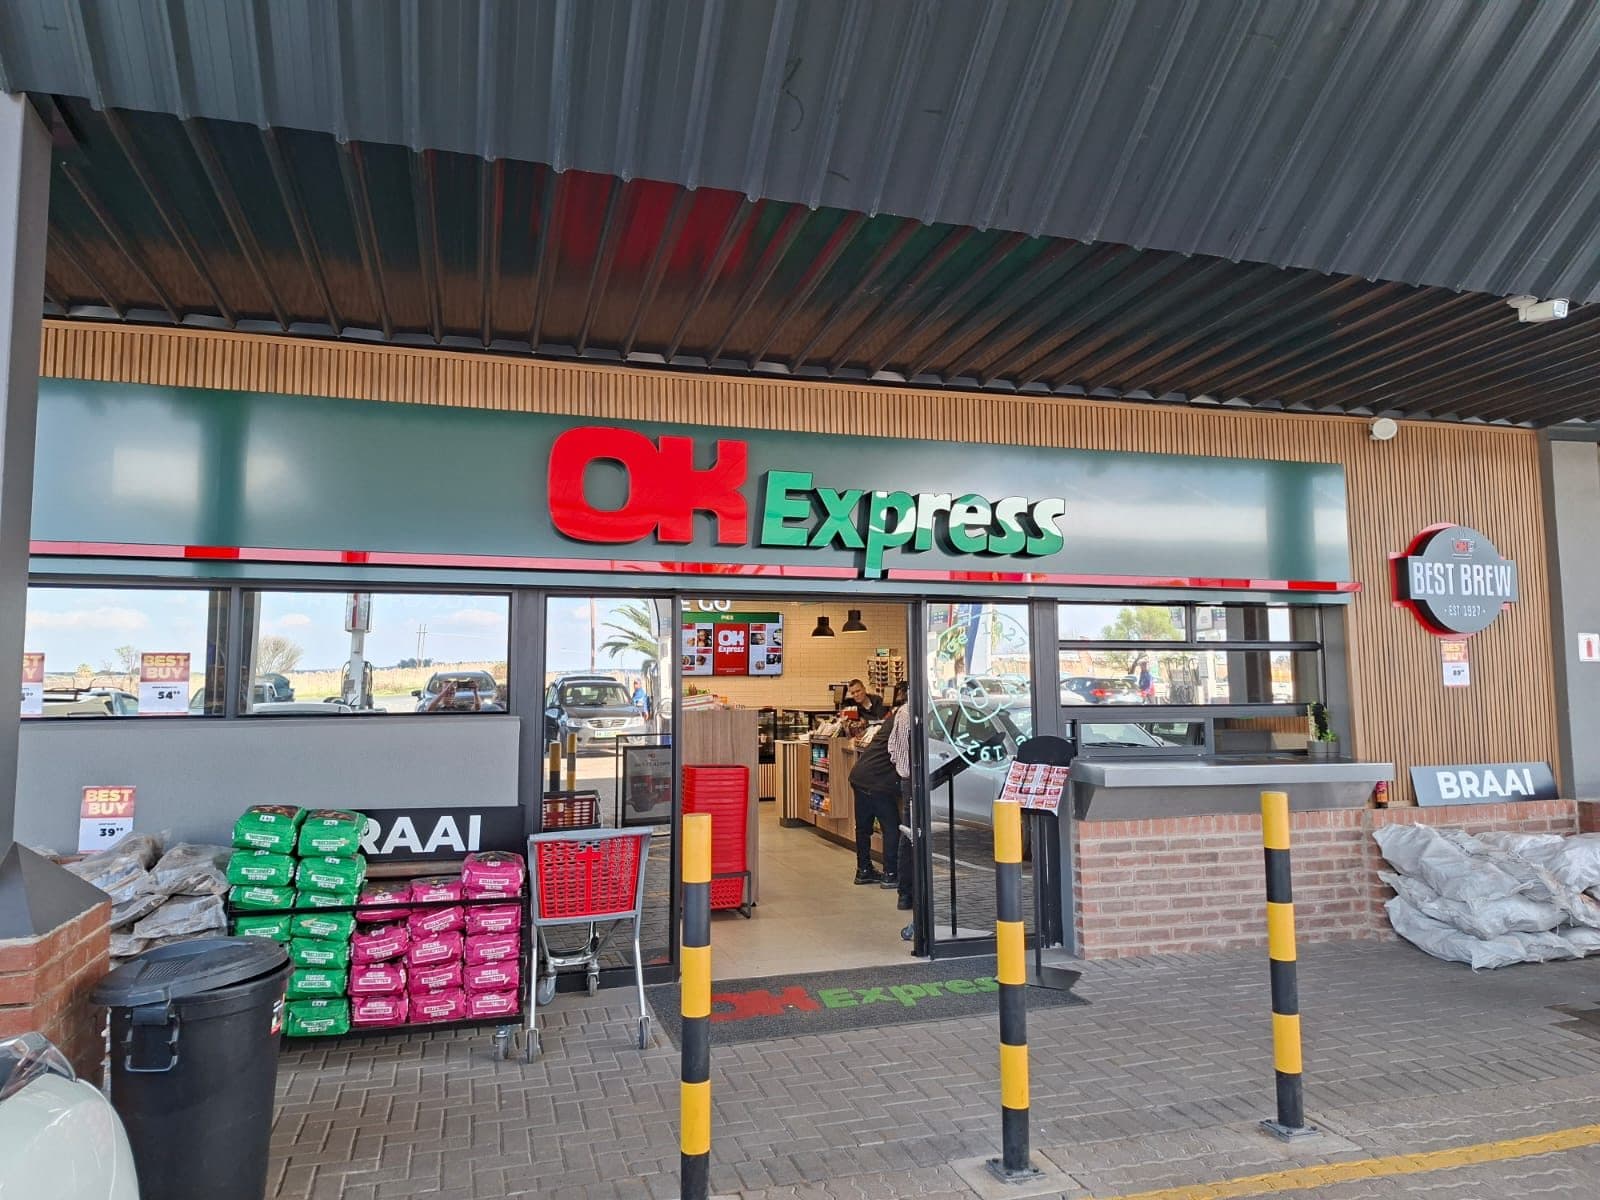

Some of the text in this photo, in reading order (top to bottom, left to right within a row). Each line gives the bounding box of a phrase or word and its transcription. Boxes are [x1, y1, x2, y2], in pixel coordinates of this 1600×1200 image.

[548, 426, 1066, 579] OK Express
[1412, 562, 1512, 597] BEST BREW
[1449, 604, 1481, 617] EST 1927
[718, 630, 744, 645] OK
[143, 655, 188, 667] BEST
[145, 667, 184, 679] BUY
[1436, 768, 1536, 799] BRAAI
[85, 789, 133, 802] BEST
[88, 802, 128, 815] BUY
[362, 815, 481, 854] RAAI
[819, 977, 998, 1008] Expres
